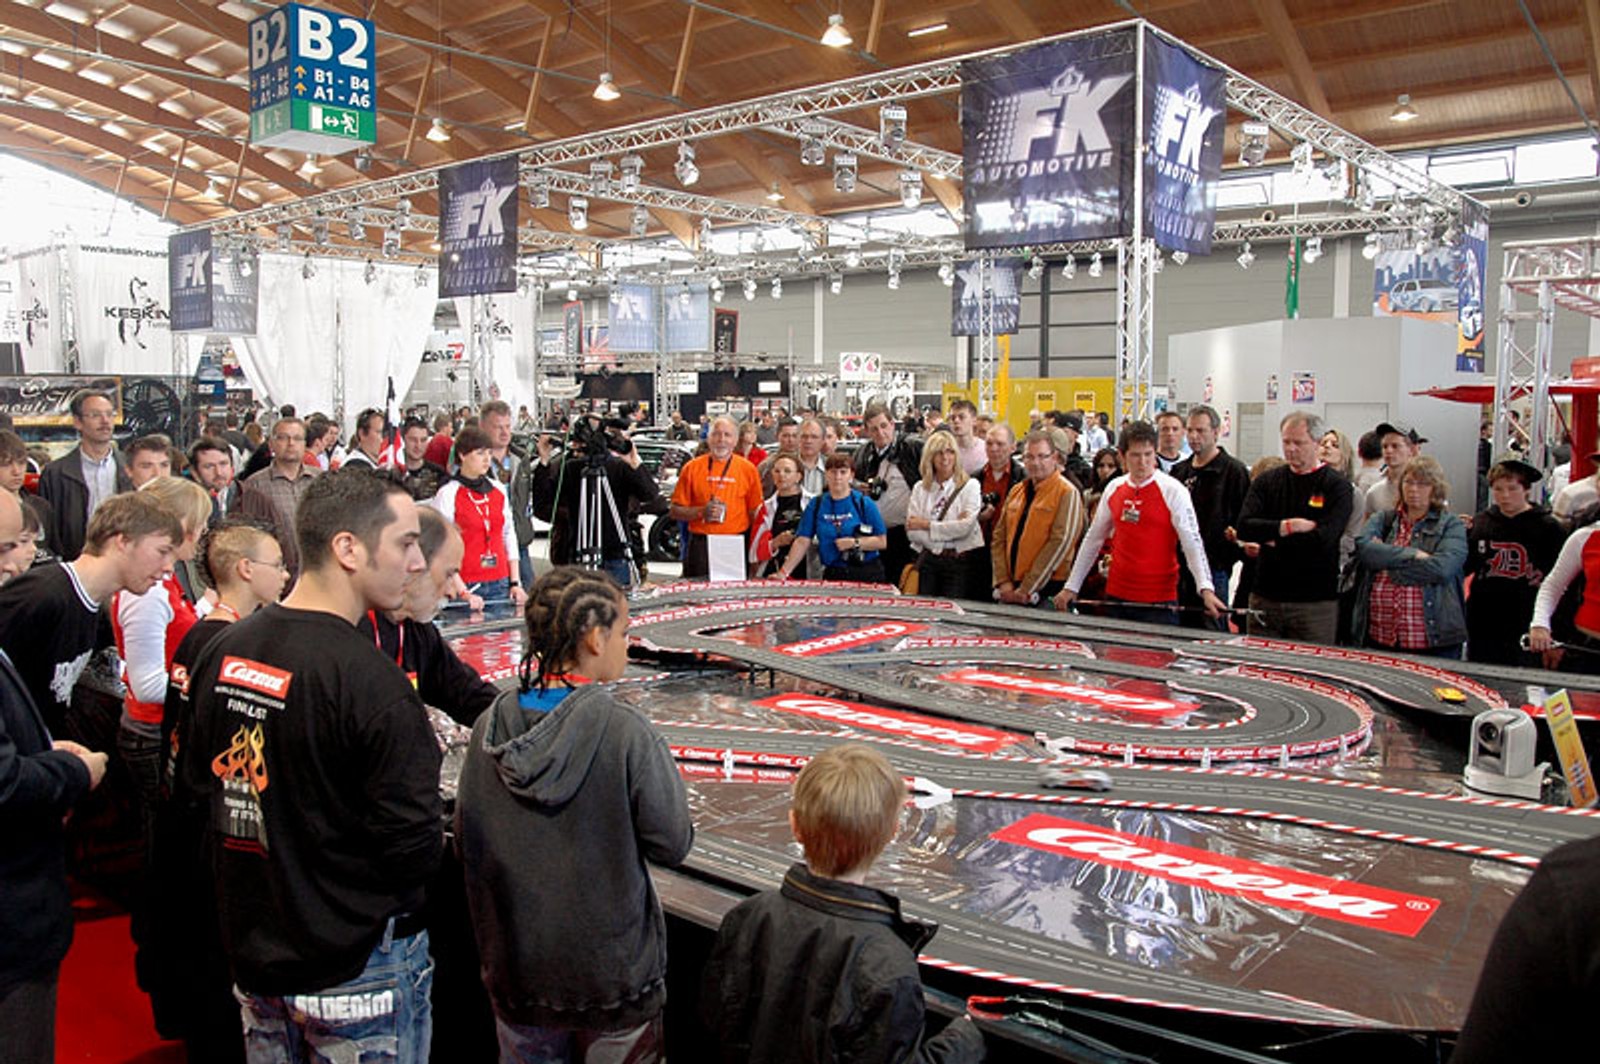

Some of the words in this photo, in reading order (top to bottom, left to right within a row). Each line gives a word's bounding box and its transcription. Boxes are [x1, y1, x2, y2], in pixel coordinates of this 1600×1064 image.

[252, 10, 287, 71] B2
[298, 8, 368, 70] B2
[313, 86, 334, 102] A1
[348, 92, 370, 108] A6
[314, 68, 333, 85] B1
[350, 75, 369, 92] B4
[1008, 73, 1135, 162] FK
[1156, 88, 1222, 172] FK
[973, 151, 1113, 184] AUTOMOTIVE
[459, 184, 517, 239] FK
[223, 661, 286, 692] Carrera
[775, 699, 997, 744] Carrera
[1026, 826, 1400, 919] Carrera
